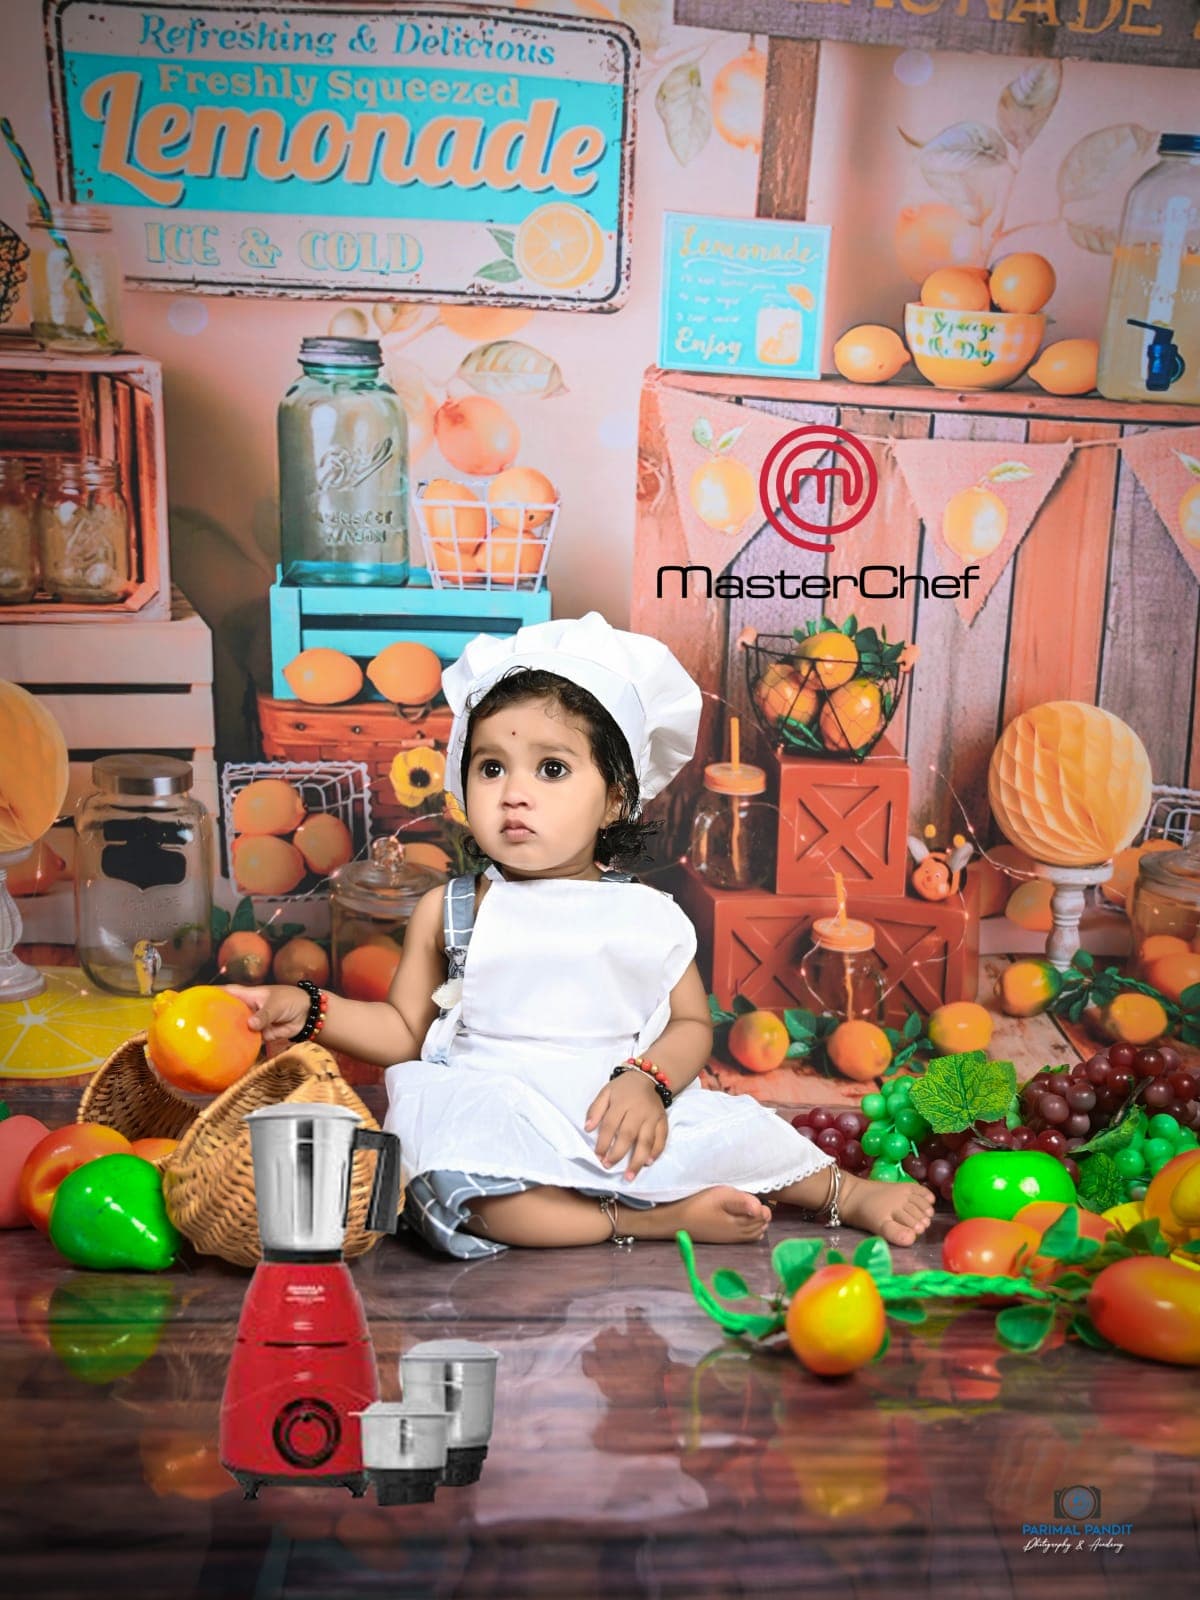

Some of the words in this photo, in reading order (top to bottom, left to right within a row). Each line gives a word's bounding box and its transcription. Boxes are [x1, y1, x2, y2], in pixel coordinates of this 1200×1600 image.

[138, 13, 336, 57] Refreshing
[348, 23, 378, 53] &
[393, 22, 556, 65] Delicious
[157, 63, 318, 106] Freshly
[327, 69, 521, 108] Squeezed
[81, 69, 607, 208] Lemonade
[144, 222, 221, 266] ICE
[238, 226, 282, 268] &
[299, 230, 424, 274] COLD
[679, 224, 820, 262] Lemonade
[674, 326, 743, 365] Enjoy
